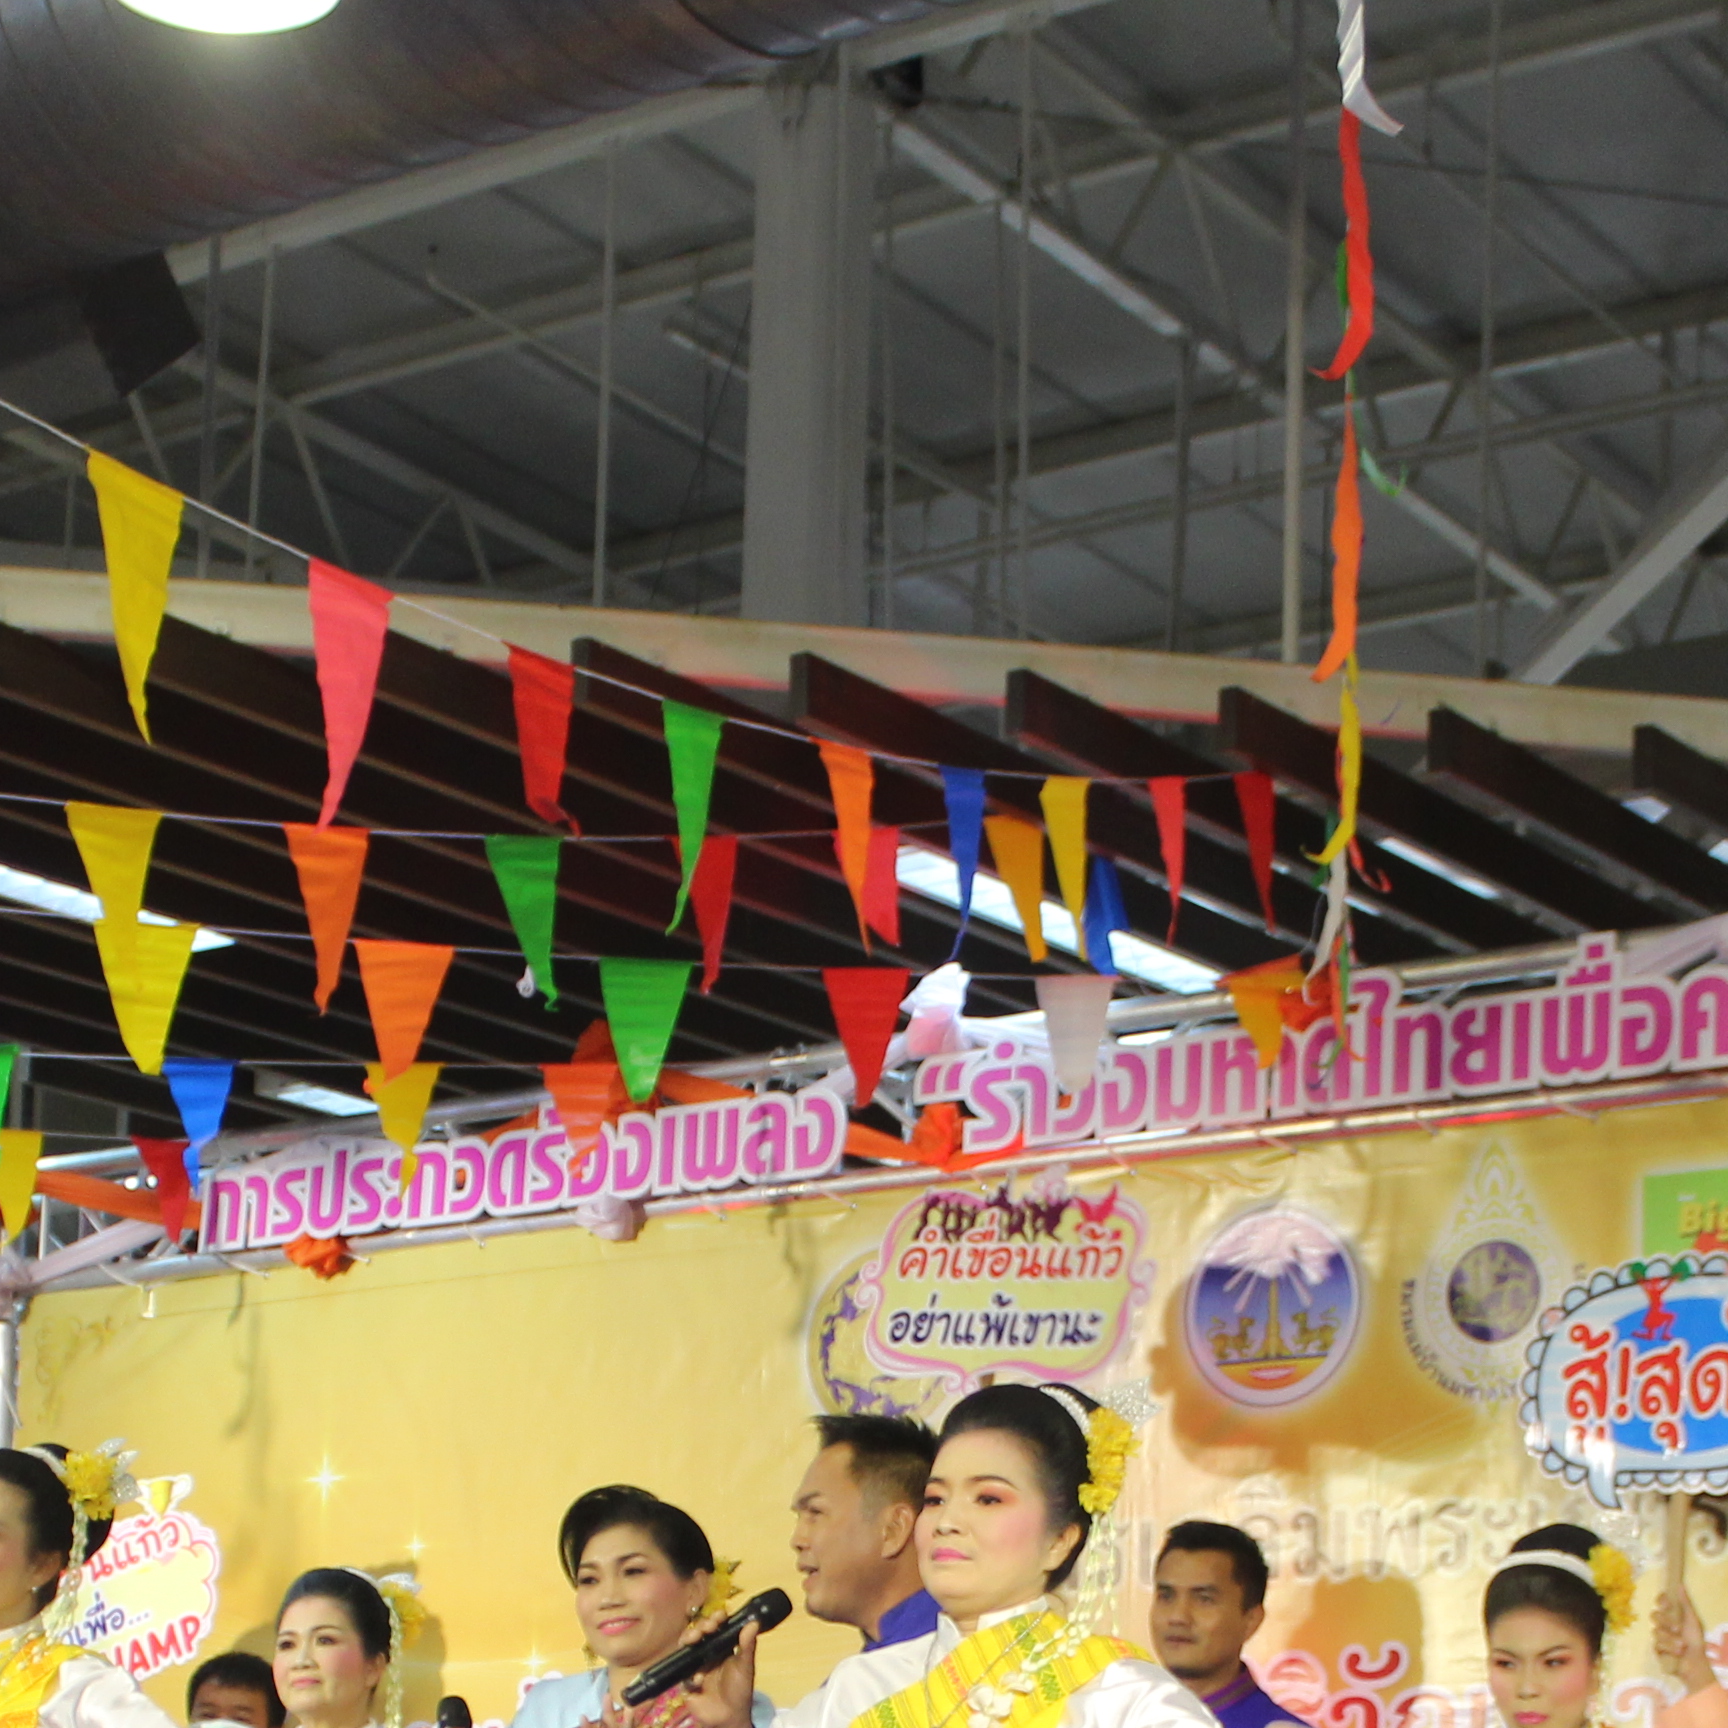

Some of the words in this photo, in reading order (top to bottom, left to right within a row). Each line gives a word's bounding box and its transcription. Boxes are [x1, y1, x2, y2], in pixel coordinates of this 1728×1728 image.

[888, 1294, 1102, 1347] อย่าแพ้เขานะ
